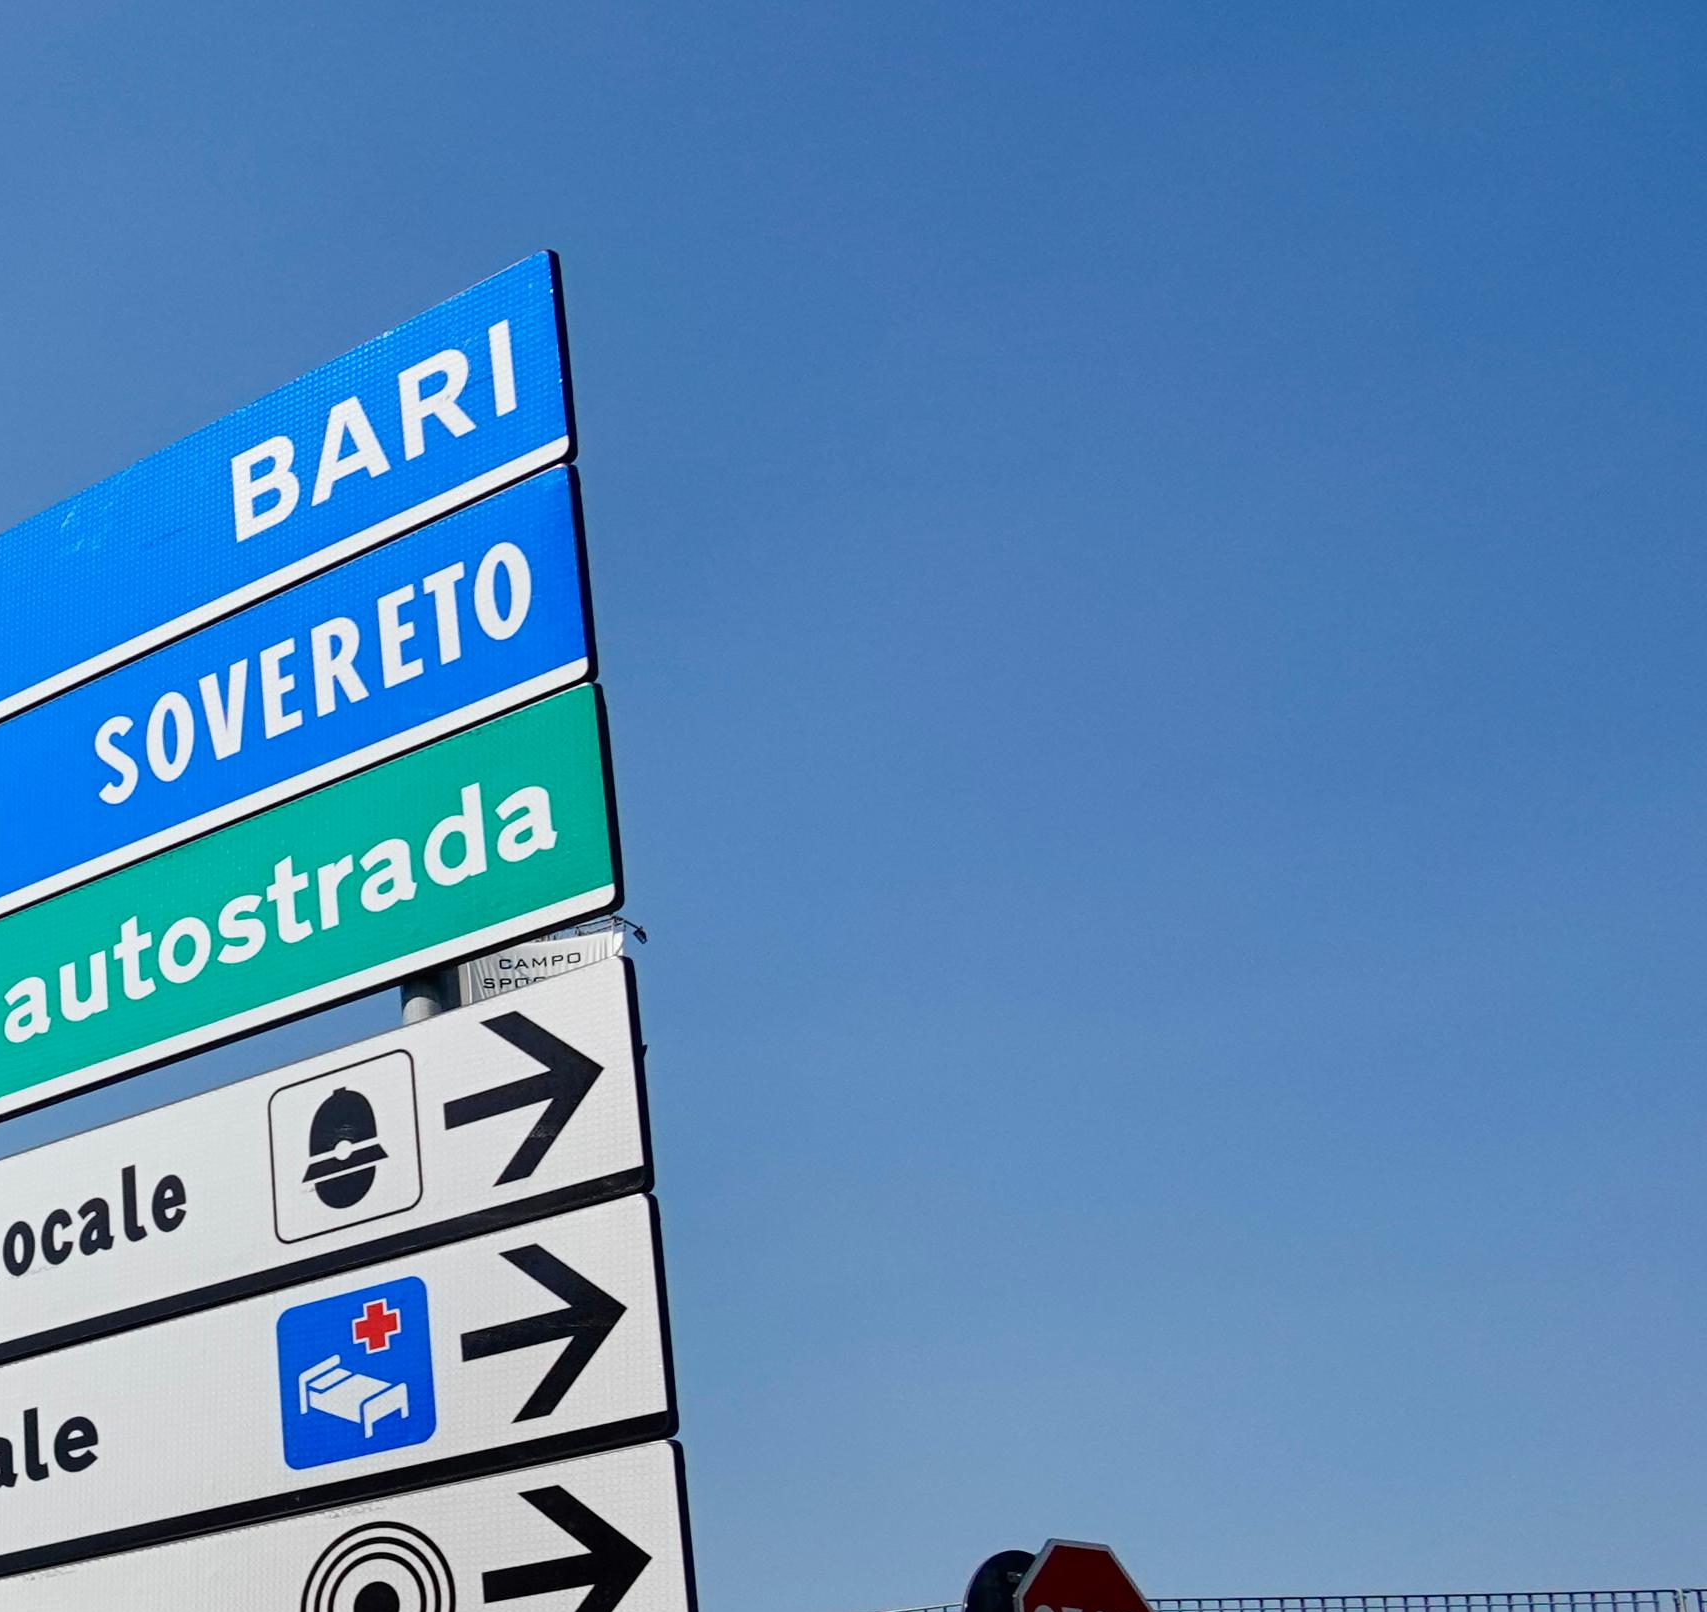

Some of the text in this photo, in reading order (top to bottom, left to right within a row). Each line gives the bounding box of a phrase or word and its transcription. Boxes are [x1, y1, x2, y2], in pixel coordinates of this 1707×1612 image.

[230, 319, 518, 543] BARI
[93, 541, 533, 806] SOVERETO
[3, 782, 559, 1044] autostrada
[498, 952, 582, 971] CAMPO
